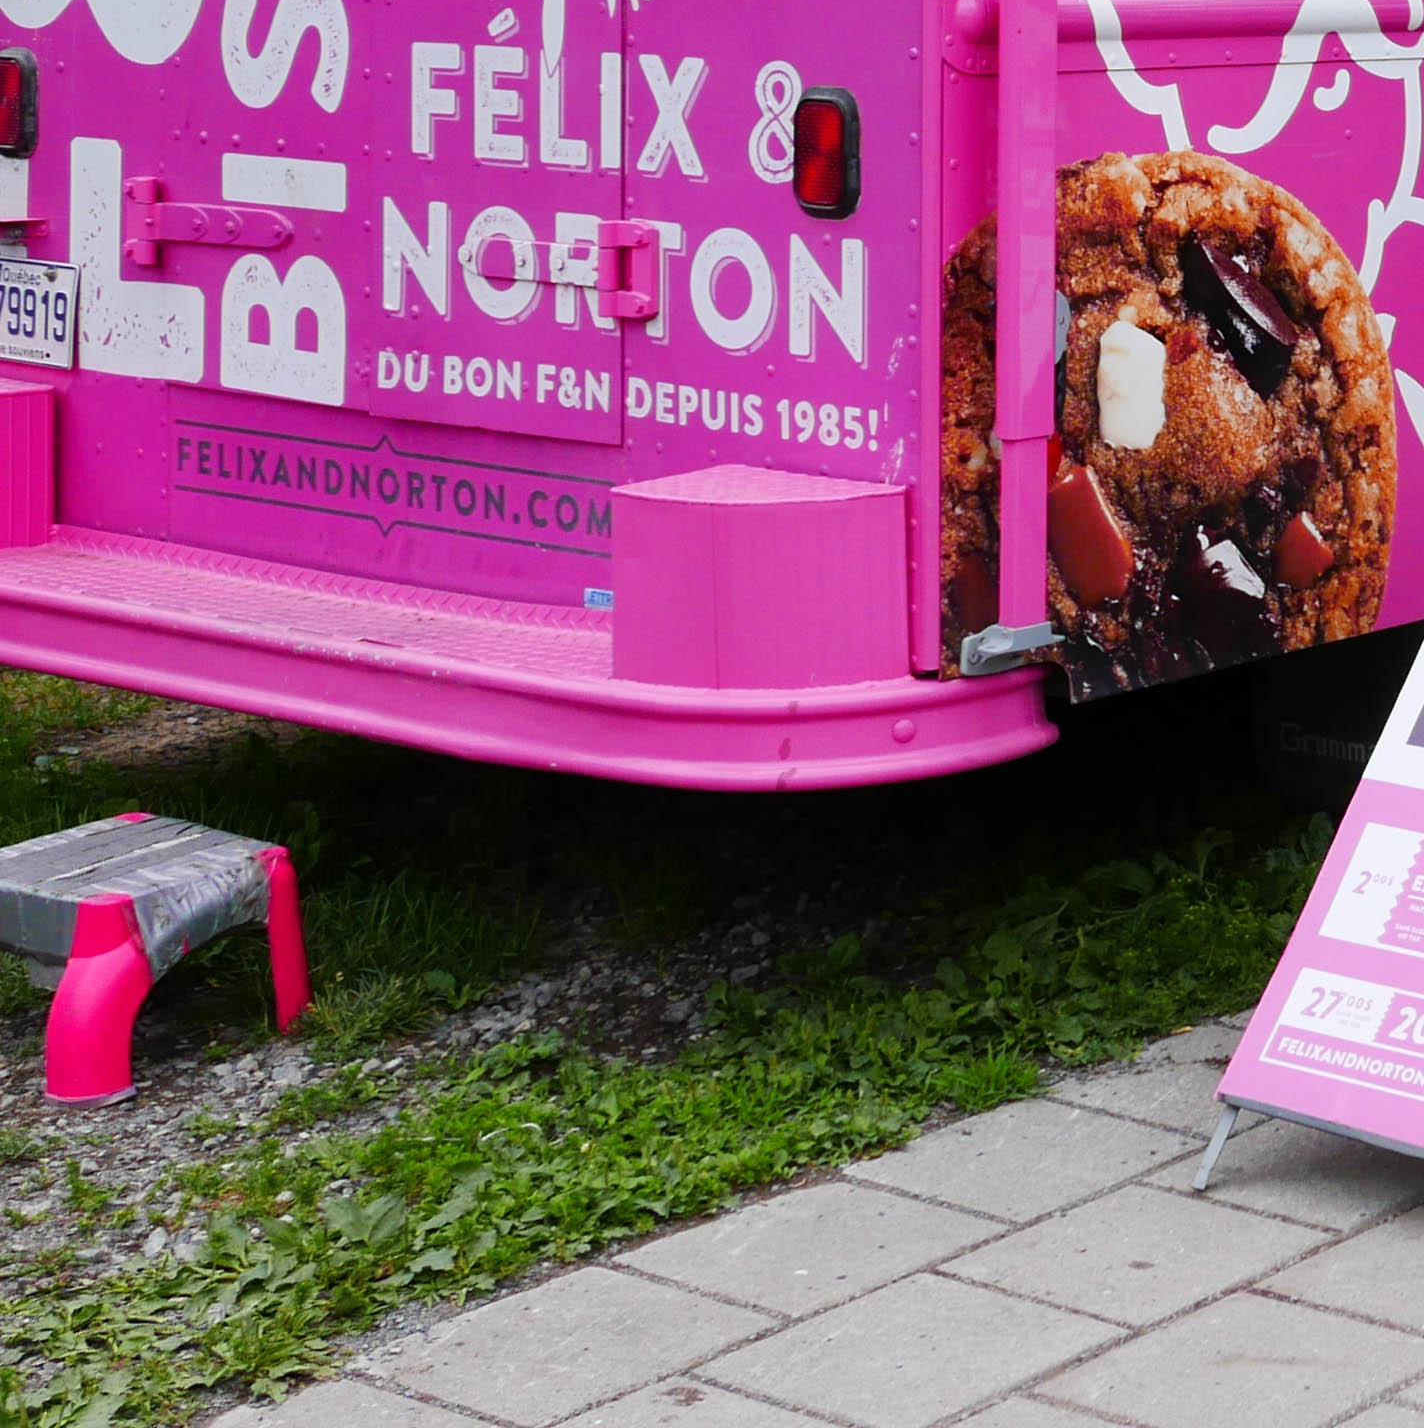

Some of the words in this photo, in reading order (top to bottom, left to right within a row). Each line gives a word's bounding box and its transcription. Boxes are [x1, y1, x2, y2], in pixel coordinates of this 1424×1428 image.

[410, 8, 709, 182] FÉLIX
[748, 59, 801, 184] &
[381, 195, 869, 369] NORTON
[377, 351, 429, 392] DU
[443, 355, 522, 401] BON
[536, 364, 611, 413] F&N
[627, 376, 763, 437] DEPUIS
[776, 398, 879, 452] 1985!
[176, 436, 613, 539] FELIXANDNORTON.COM
